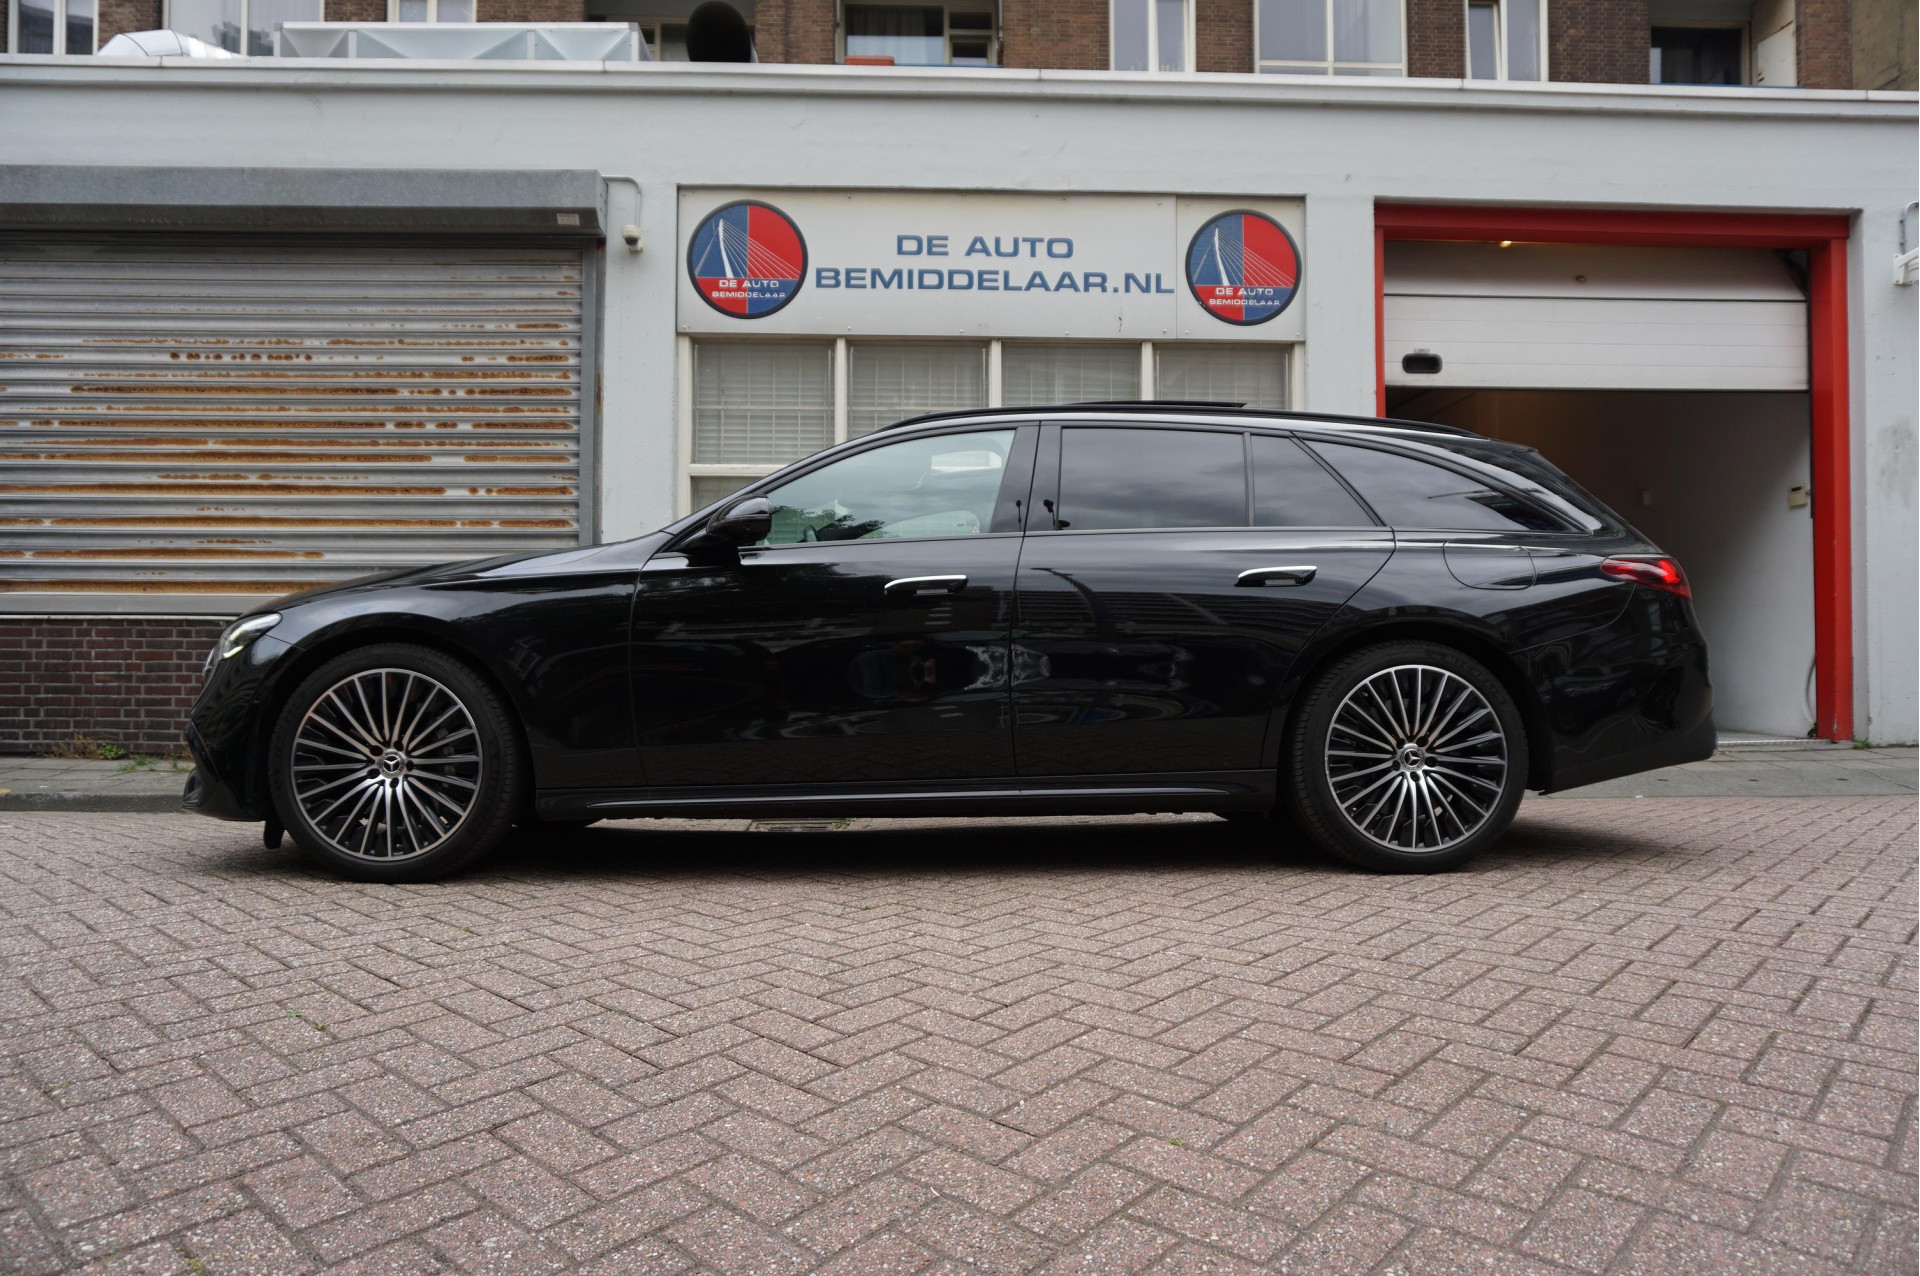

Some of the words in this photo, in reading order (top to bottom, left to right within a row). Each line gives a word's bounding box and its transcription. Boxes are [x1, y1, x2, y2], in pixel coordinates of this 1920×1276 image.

[896, 234, 949, 256] DE
[964, 236, 1074, 258] AUTO
[719, 280, 738, 288] DE
[742, 280, 779, 288] AUTO
[815, 267, 1175, 294] BEMIDDELAAR.NL
[1215, 287, 1234, 295] DE
[1238, 287, 1274, 295] AUTO
[1209, 298, 1280, 306] BEMIDDELAAR
